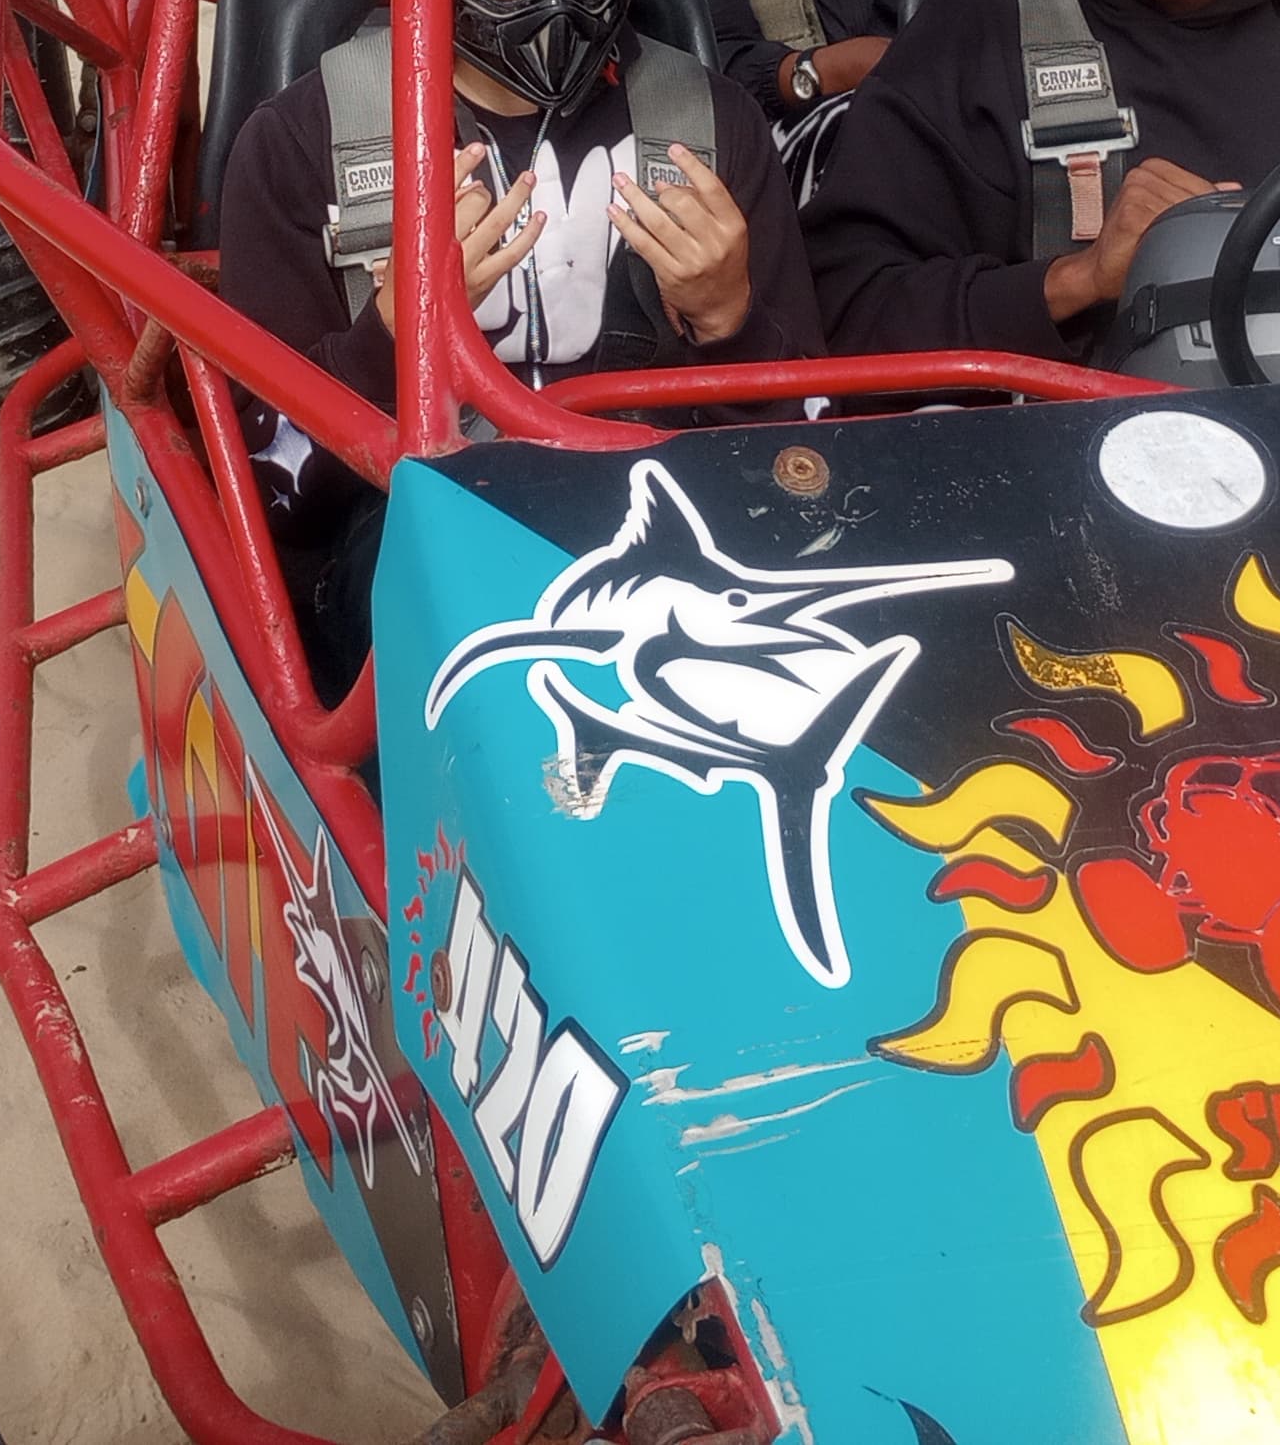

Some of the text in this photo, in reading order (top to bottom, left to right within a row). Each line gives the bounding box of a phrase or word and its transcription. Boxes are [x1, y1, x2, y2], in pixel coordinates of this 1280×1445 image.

[1039, 68, 1082, 86] CROW
[348, 165, 393, 186] CROW
[435, 867, 628, 1270] 420
